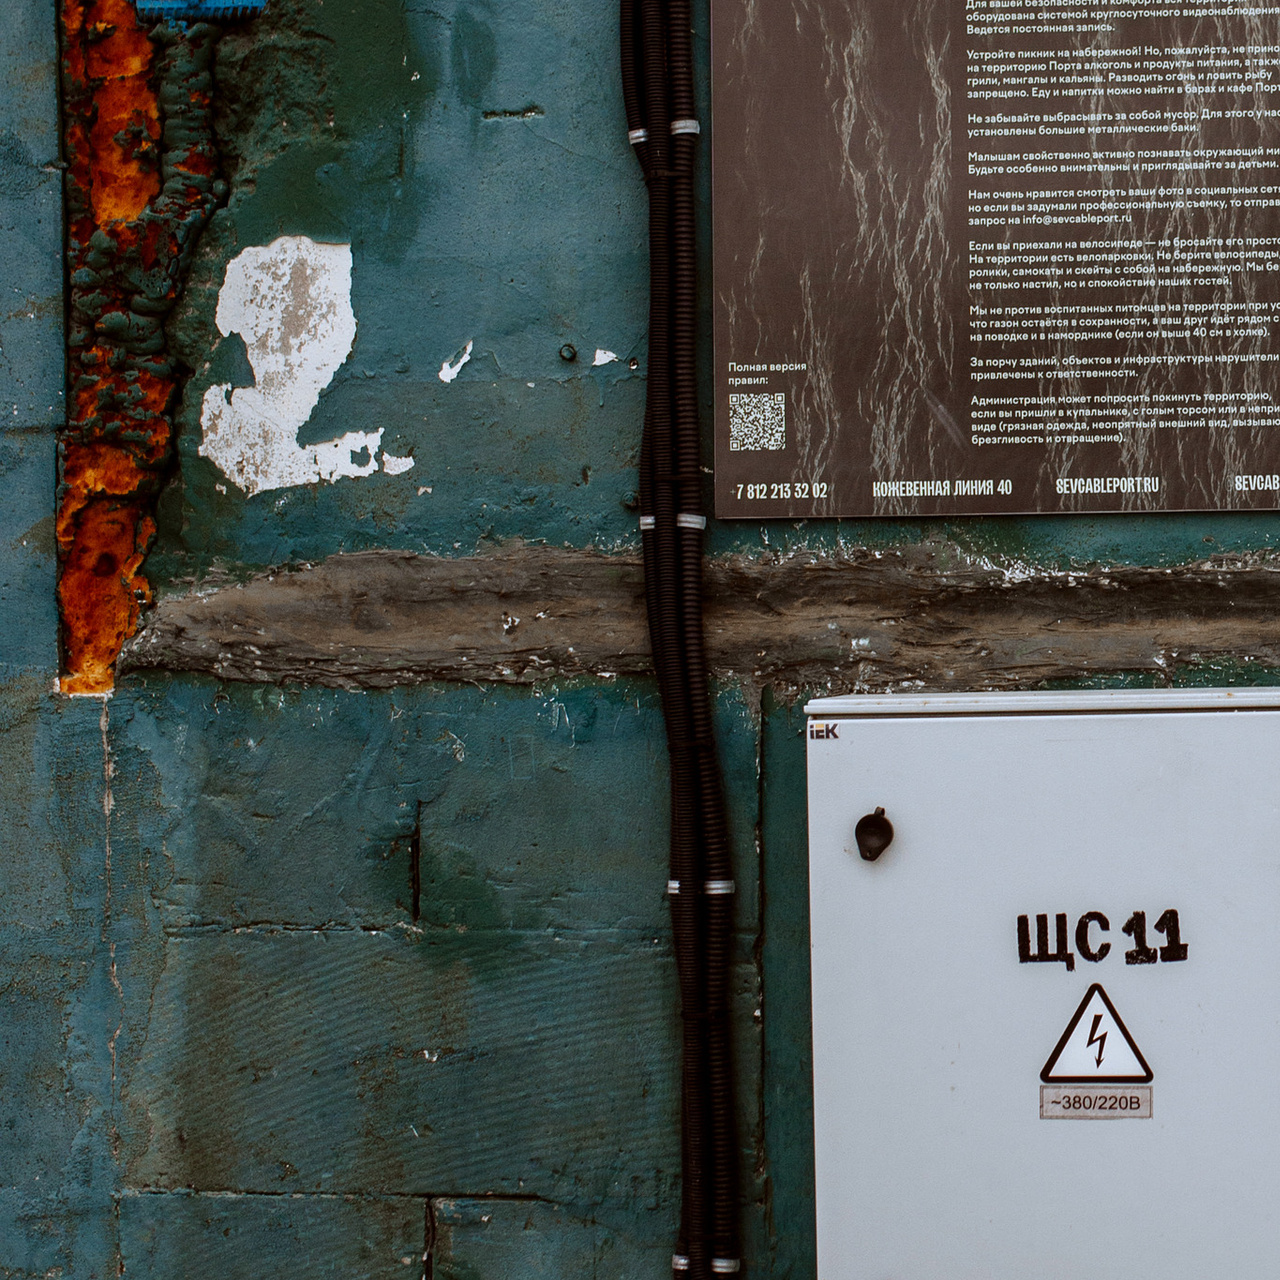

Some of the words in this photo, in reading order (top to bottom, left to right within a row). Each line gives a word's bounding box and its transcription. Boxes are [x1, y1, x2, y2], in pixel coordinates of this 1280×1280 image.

[965, 10, 1035, 23] оборудована
[1037, 8, 1087, 19] системой
[1090, 8, 1180, 21] круглосуточного
[966, 23, 1010, 35] Ведется
[1012, 24, 1074, 33] постоянная
[1076, 23, 1115, 32] запись.
[966, 48, 1015, 61] Устройте
[1017, 49, 1055, 58] пикник
[1057, 49, 1069, 57] на
[1072, 45, 1141, 59] набережной!
[1144, 45, 1162, 57] Но,
[1164, 44, 1230, 57] пожалуйста,
[1232, 46, 1245, 54] не
[966, 63, 979, 72] на
[981, 62, 1046, 74] территорию
[1049, 60, 1081, 73] Порта
[1084, 61, 1132, 69] алкоголь
[1143, 59, 1194, 71] продукты
[1196, 58, 1242, 68] питания,
[967, 127, 1036, 139] установлены
[1038, 124, 1085, 135] большие
[1087, 124, 1168, 134] металлические
[1170, 122, 1198, 132] баки.
[968, 151, 1020, 161] Малышам
[1022, 149, 1090, 160] свойственно
[1092, 150, 1135, 159] активно
[1137, 149, 1191, 158] познавать
[1193, 145, 1263, 159] окружающий
[968, 163, 1003, 176] Будьте
[1006, 162, 1057, 173] особенно
[1060, 163, 1130, 172] внимательны
[1141, 159, 1222, 173] приглядывайте
[1224, 161, 1235, 169] за
[1237, 160, 1279, 170] детьми.
[968, 216, 1005, 227] запрос
[1008, 216, 1020, 224] на
[969, 253, 983, 263] На
[986, 254, 1048, 265] территории
[1050, 253, 1074, 262] есть
[1076, 252, 1153, 263] велопарковки.
[1156, 249, 1171, 260] Не
[1173, 249, 1211, 262] берите
[728, 362, 768, 373] Полная
[769, 363, 807, 373] версия
[970, 356, 983, 366] За
[985, 358, 1017, 369] порчу
[1019, 355, 1059, 367] зданий,
[1061, 354, 1111, 365] объектов
[1123, 354, 1212, 366] инфраструктуры
[1214, 353, 1279, 365] нарушители
[728, 376, 769, 387] правил:
[970, 371, 1035, 382] привлечены
[1045, 369, 1138, 378] ответственности.
[971, 394, 1055, 407] Администрация
[1058, 395, 1091, 404] может
[1093, 394, 1150, 405] попросить
[1152, 393, 1201, 404] покинуть
[1203, 392, 1272, 404] территорию,
[971, 422, 996, 432] виде
[998, 420, 1044, 433] (грязная
[1046, 421, 1089, 431] одежда,
[1092, 418, 1156, 431] неопрятный
[1158, 417, 1205, 428] внешний
[1208, 419, 1230, 429] вид,
[971, 434, 1043, 447] брезгливость
[1054, 431, 1127, 445] отвращение).
[746, 483, 768, 499] 812
[770, 483, 791, 499] 213
[794, 483, 810, 499] 32
[812, 482, 828, 498] 02
[872, 480, 951, 498] КОЖЕВЕННАЯ
[953, 480, 994, 496] ЛИНИЯ
[997, 479, 1013, 496] 40
